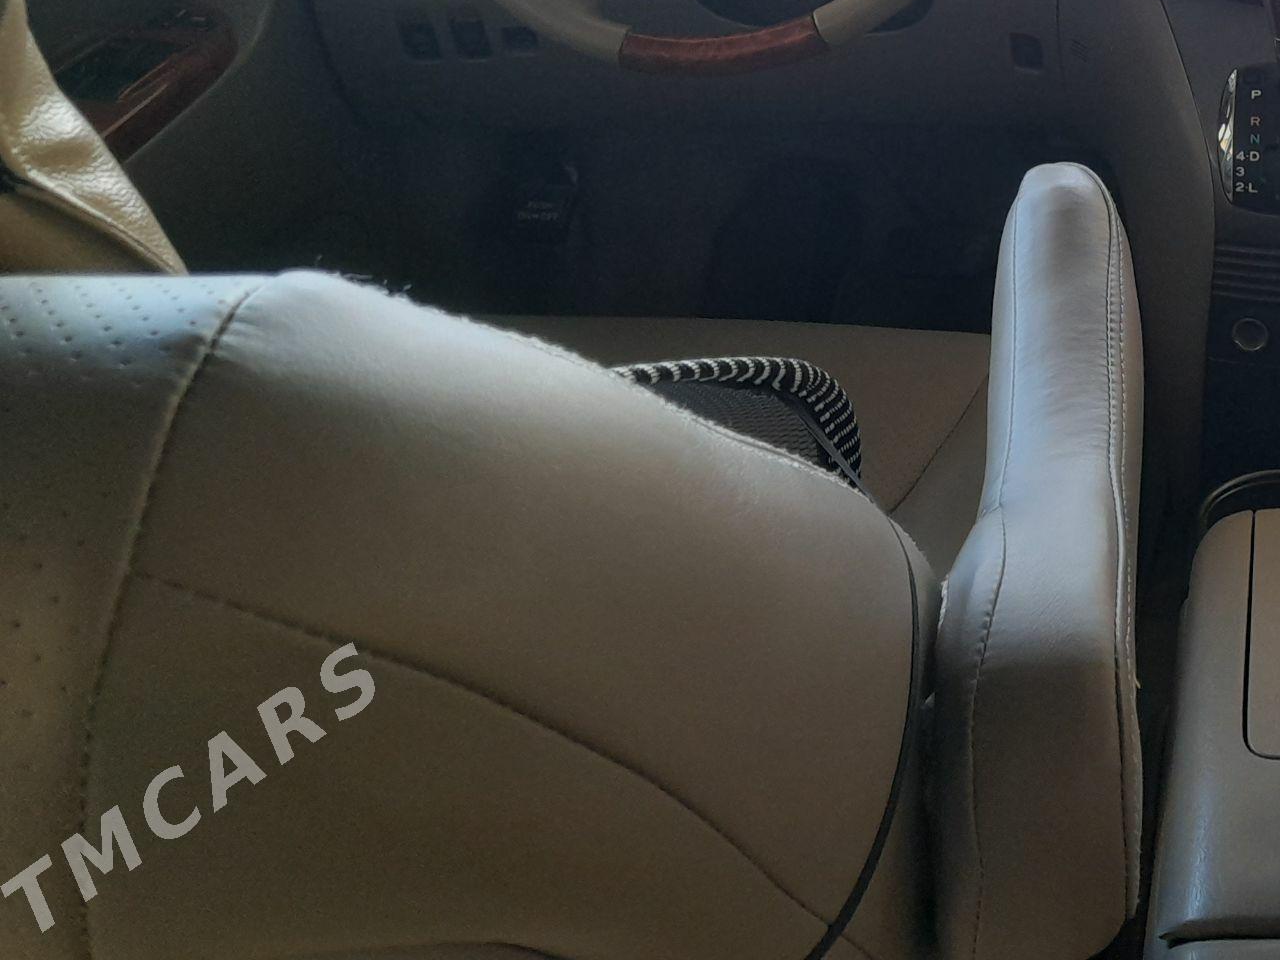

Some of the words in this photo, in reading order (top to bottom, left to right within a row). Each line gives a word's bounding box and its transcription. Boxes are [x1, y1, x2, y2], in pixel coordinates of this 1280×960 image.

[1251, 89, 1262, 100] P
[1250, 115, 1261, 127] R
[1249, 133, 1261, 145] N
[1235, 166, 1245, 177] 3
